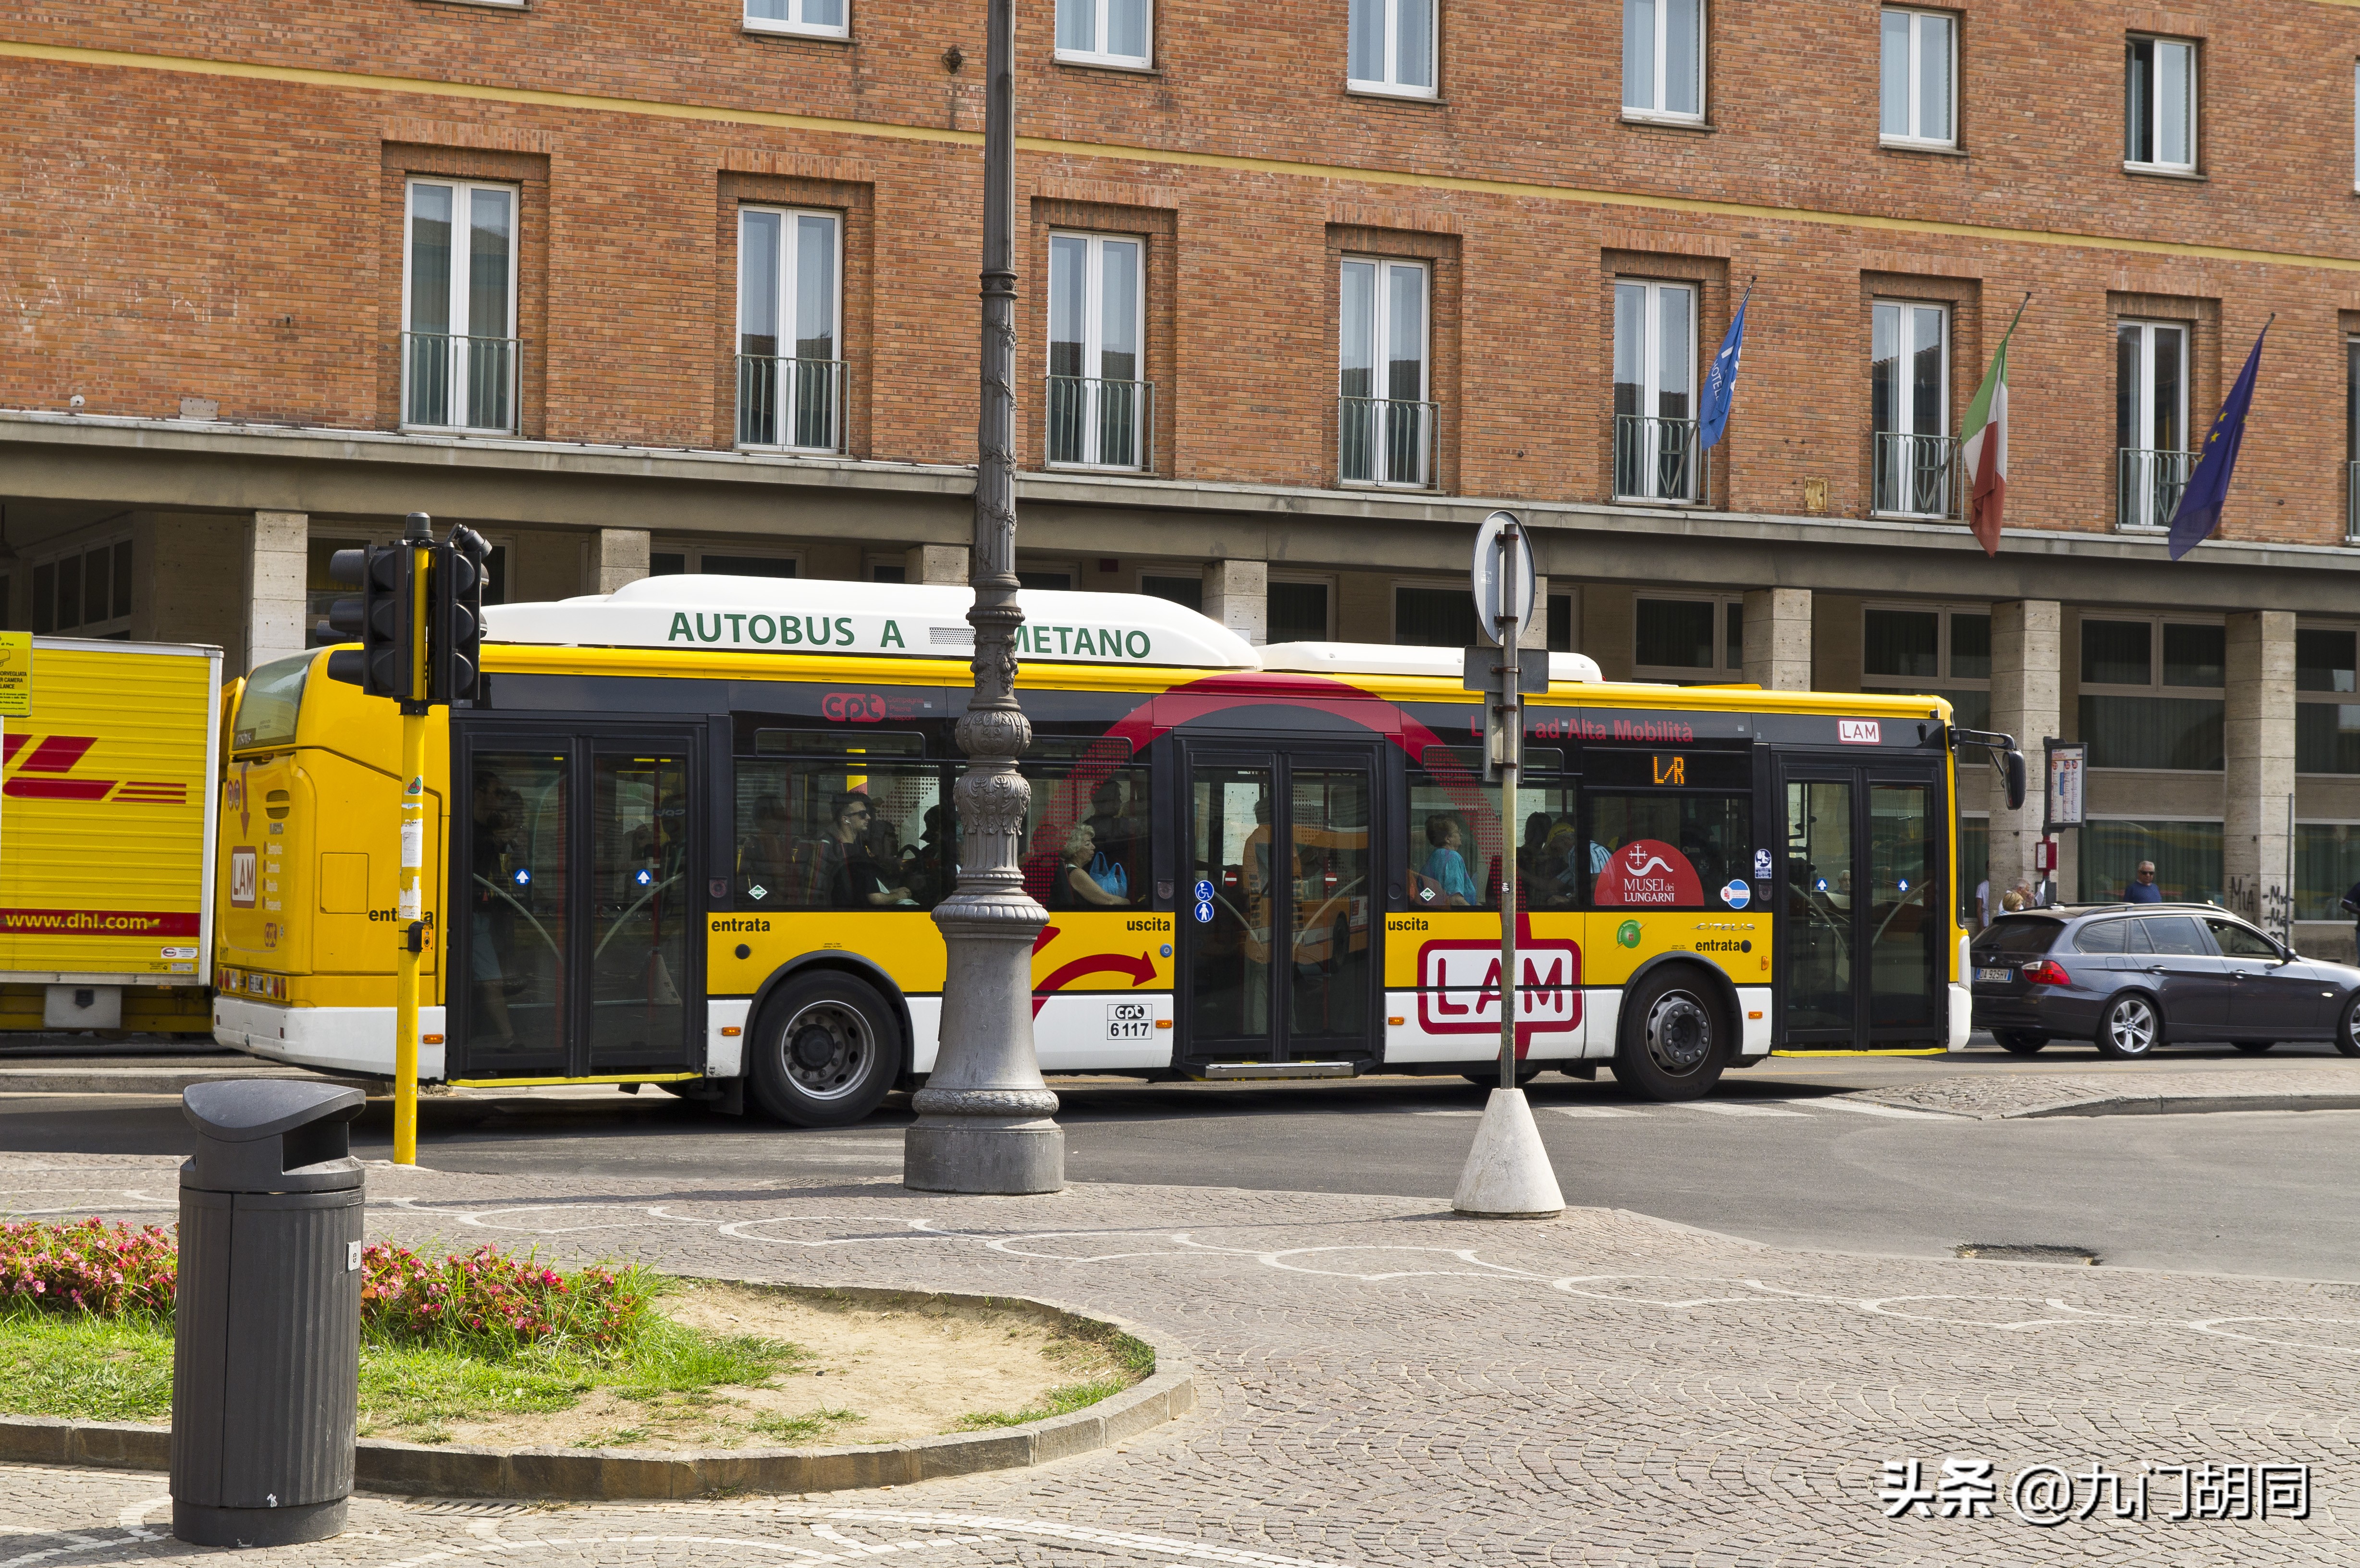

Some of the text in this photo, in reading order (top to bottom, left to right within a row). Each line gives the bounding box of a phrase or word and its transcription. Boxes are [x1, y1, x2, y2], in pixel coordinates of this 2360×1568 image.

[668, 612, 855, 646] AUTOBUS
[880, 620, 906, 648] A
[825, 693, 881, 722] cpt
[1536, 718, 1560, 739] ad
[1568, 718, 1606, 740] Alta
[1613, 719, 1693, 742] Mobilità
[1843, 723, 1876, 739] LAM
[234, 858, 254, 895] LAM
[1624, 878, 1674, 892] MUSEI dei
[1624, 892, 1675, 902] LUNGARNI
[6, 913, 148, 930] www.dhl.com
[369, 907, 433, 922] enta
[711, 918, 770, 932] entrata
[1127, 917, 1170, 931] uscita
[1388, 917, 1428, 931] uscita
[1695, 939, 1740, 951] entrata
[1438, 957, 1563, 1015] LAM
[1116, 1005, 1143, 1019] cpt
[1110, 1023, 1149, 1037] 6117
